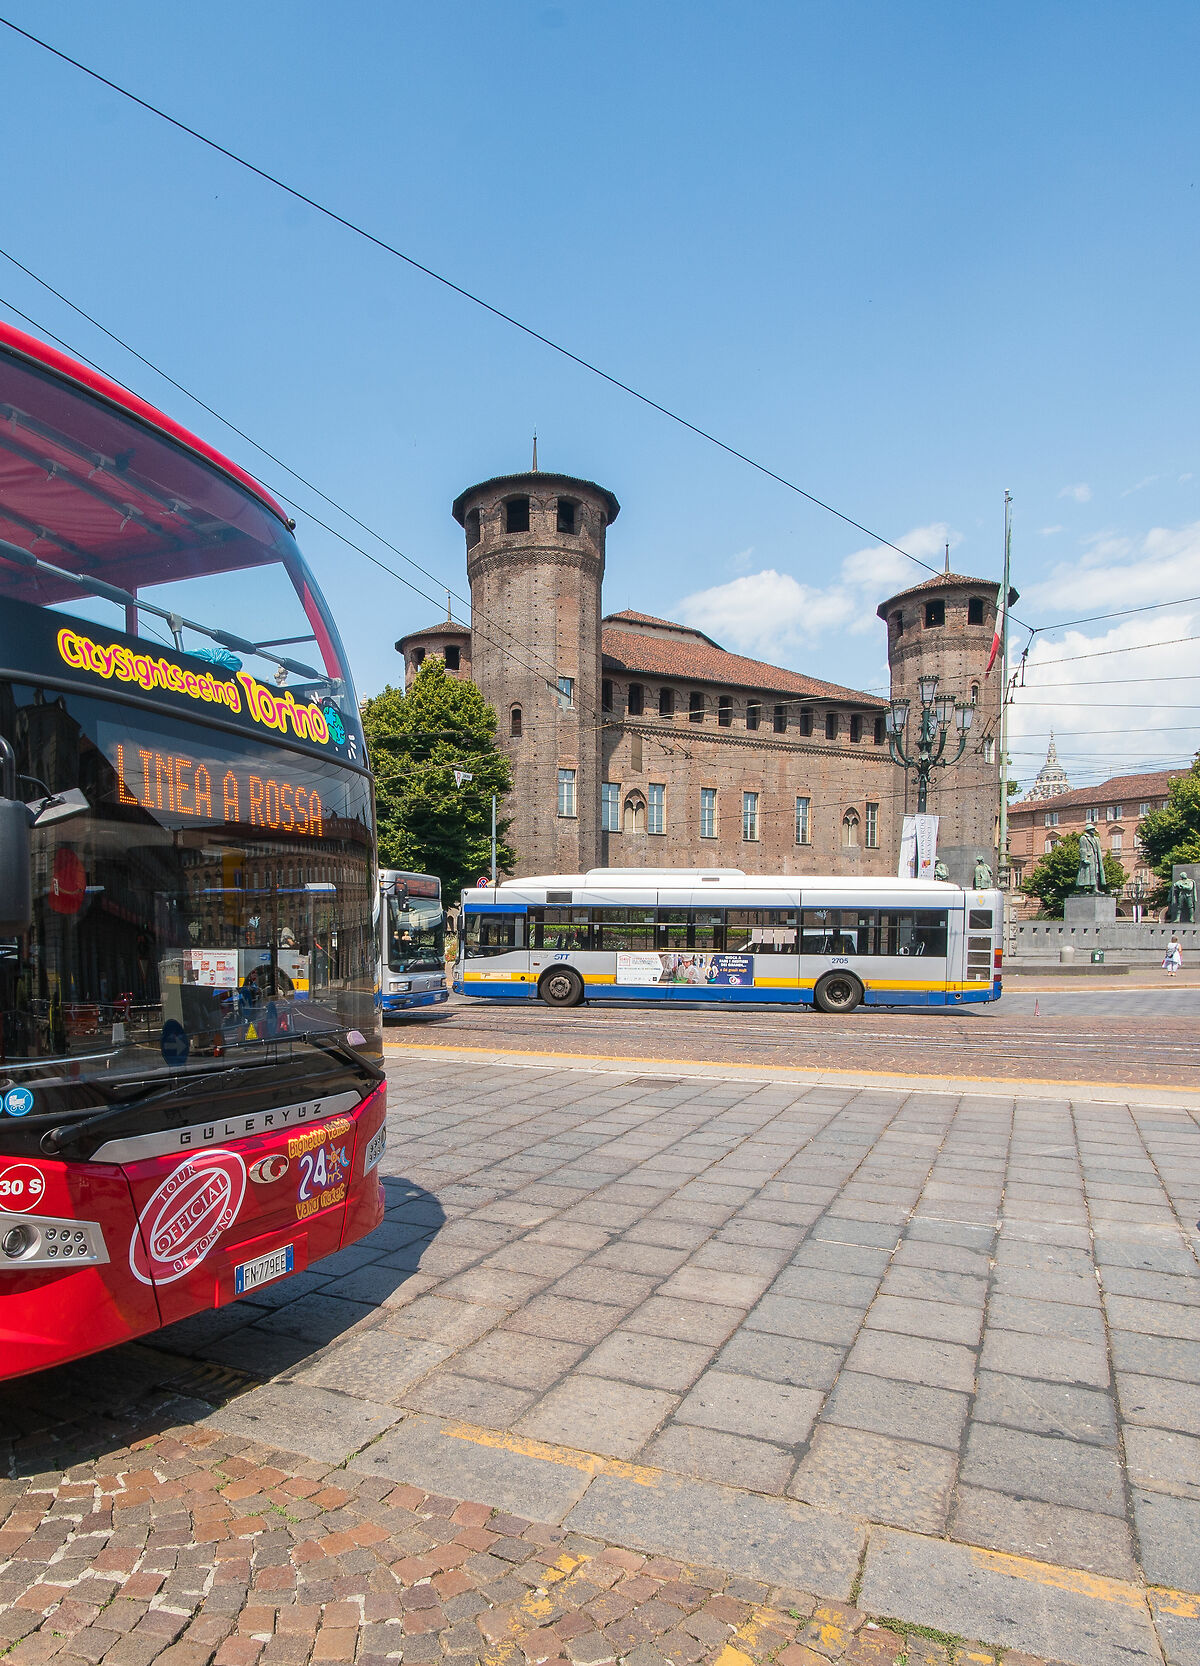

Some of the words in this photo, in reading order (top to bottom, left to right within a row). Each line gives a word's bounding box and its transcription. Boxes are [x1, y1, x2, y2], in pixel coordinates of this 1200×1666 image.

[57, 628, 242, 713] CitySightseeing
[236, 672, 330, 744] Torino
[117, 745, 212, 818] LINEA
[223, 770, 240, 822] A
[249, 775, 323, 837] ROSSA
[288, 1129, 326, 1160] Biglietto
[28, 1178, 42, 1194] S
[158, 1164, 197, 1202] TOUR
[299, 1148, 327, 1200] 24
[156, 1178, 228, 1252] OFFICIAL
[173, 1254, 191, 1273] OF
[192, 1208, 233, 1256] TORINO
